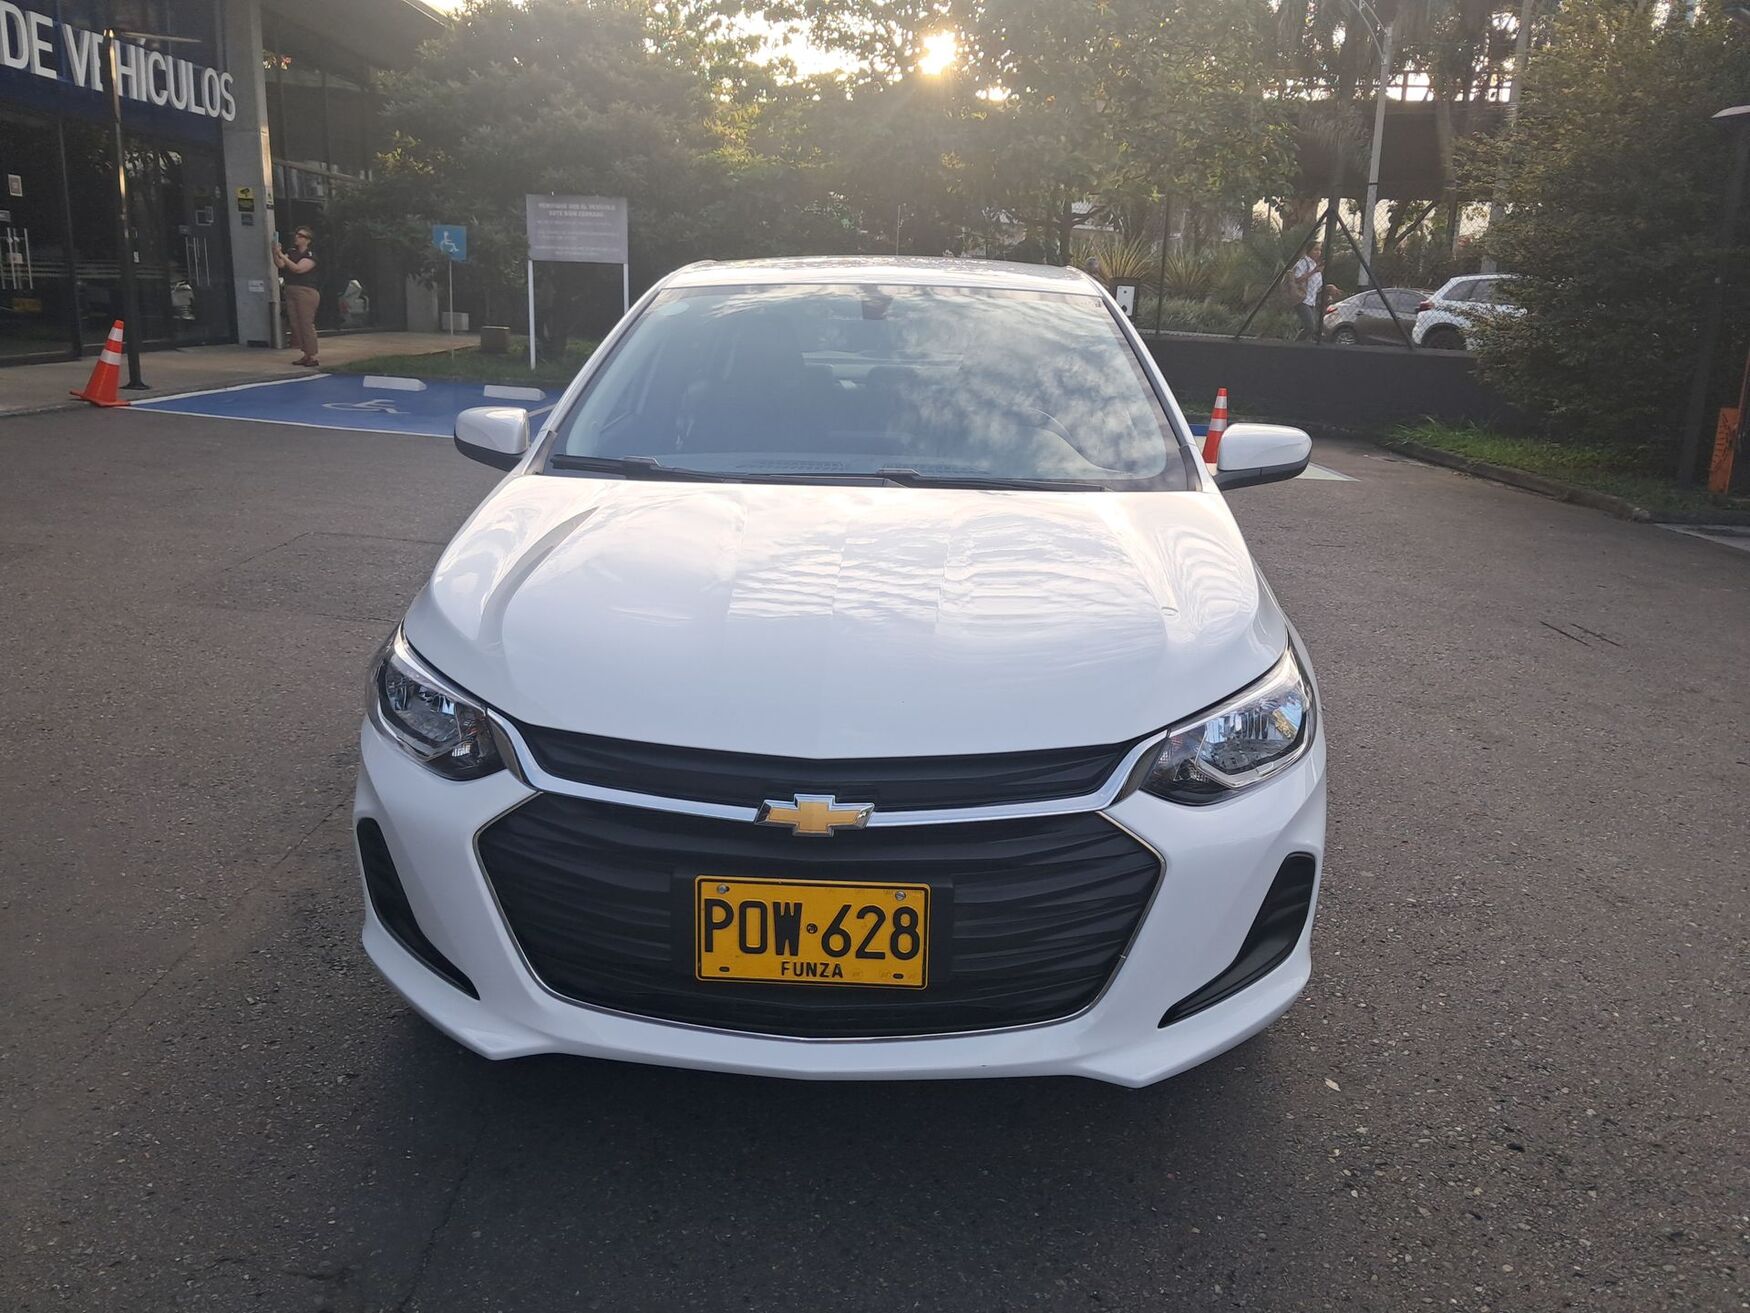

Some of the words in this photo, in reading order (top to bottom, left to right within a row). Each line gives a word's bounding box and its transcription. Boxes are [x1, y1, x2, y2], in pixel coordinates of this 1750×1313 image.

[0, 2, 57, 80] DE
[703, 898, 803, 956] POW
[821, 904, 920, 960] 628
[780, 960, 844, 979] FUNZA
